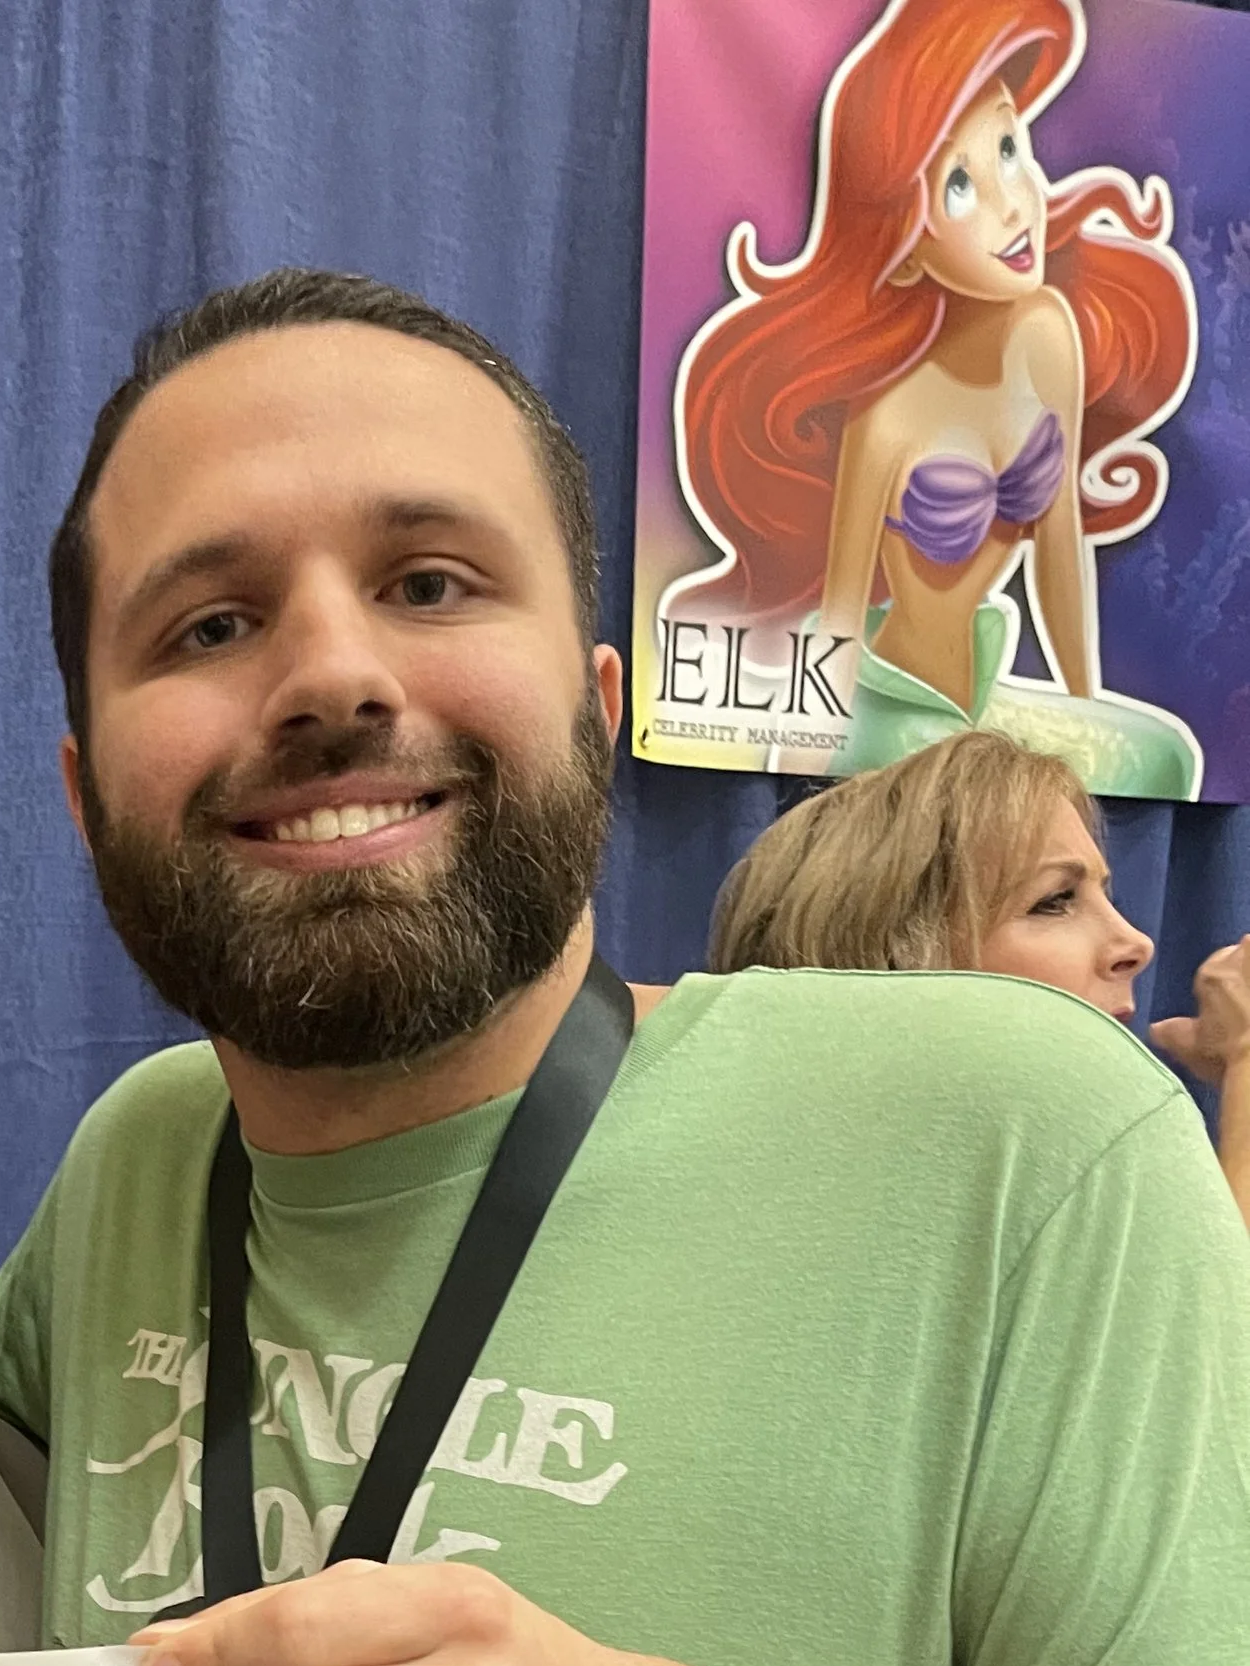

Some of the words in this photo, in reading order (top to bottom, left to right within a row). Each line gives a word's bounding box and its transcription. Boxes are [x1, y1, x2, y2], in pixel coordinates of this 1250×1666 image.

[656, 617, 857, 720] ELK
[653, 718, 740, 744] CELEBRITY
[749, 727, 849, 751] MANAGEMENT
